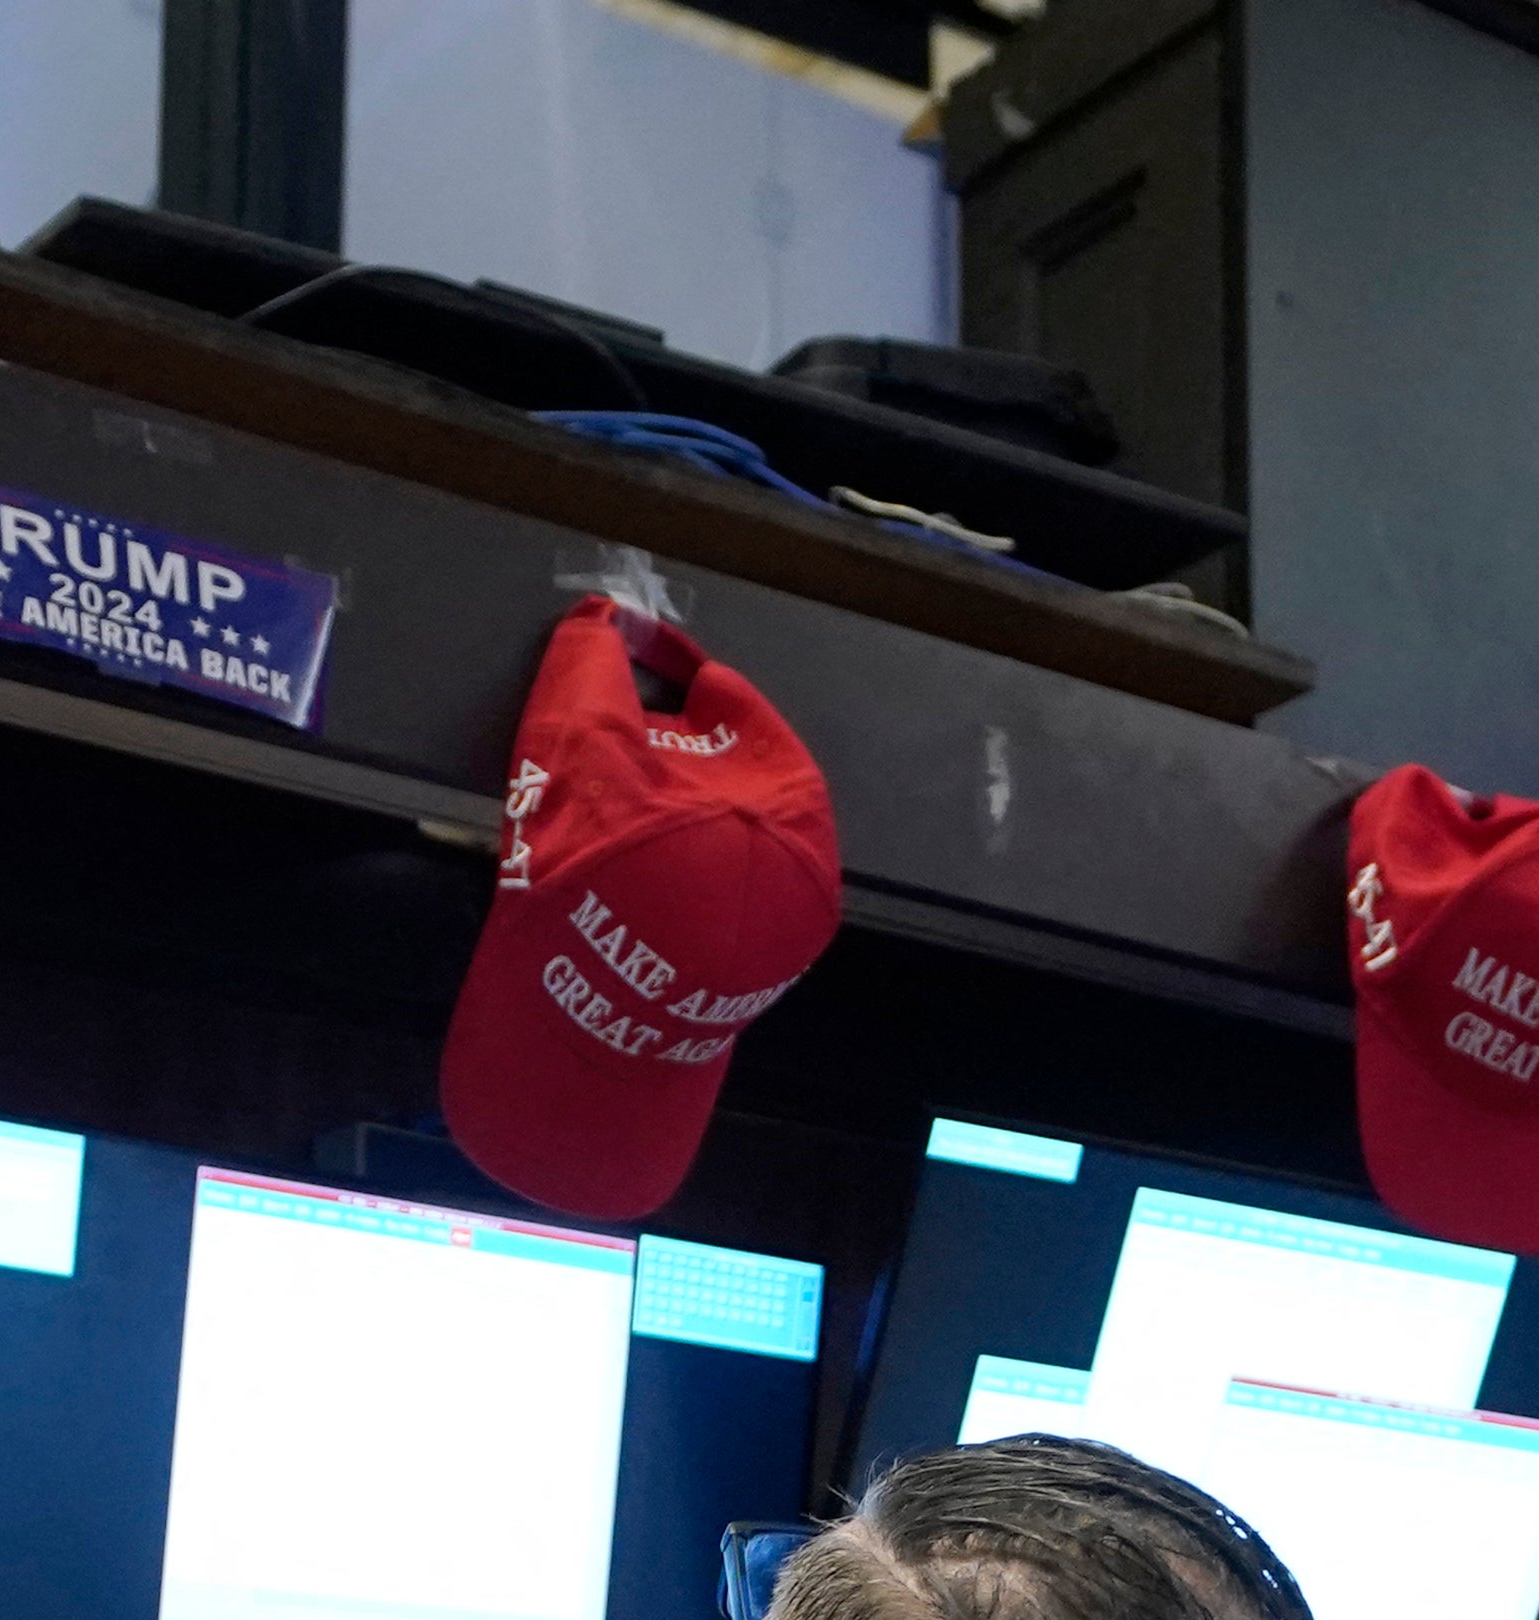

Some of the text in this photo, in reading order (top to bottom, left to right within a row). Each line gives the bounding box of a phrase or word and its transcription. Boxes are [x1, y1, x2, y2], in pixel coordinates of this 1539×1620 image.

[20, 596, 190, 670] AMERICA
[200, 648, 292, 702] BACK
[48, 571, 163, 631] 2024
[568, 891, 677, 999] MAKE
[541, 954, 662, 1057] GREAT
